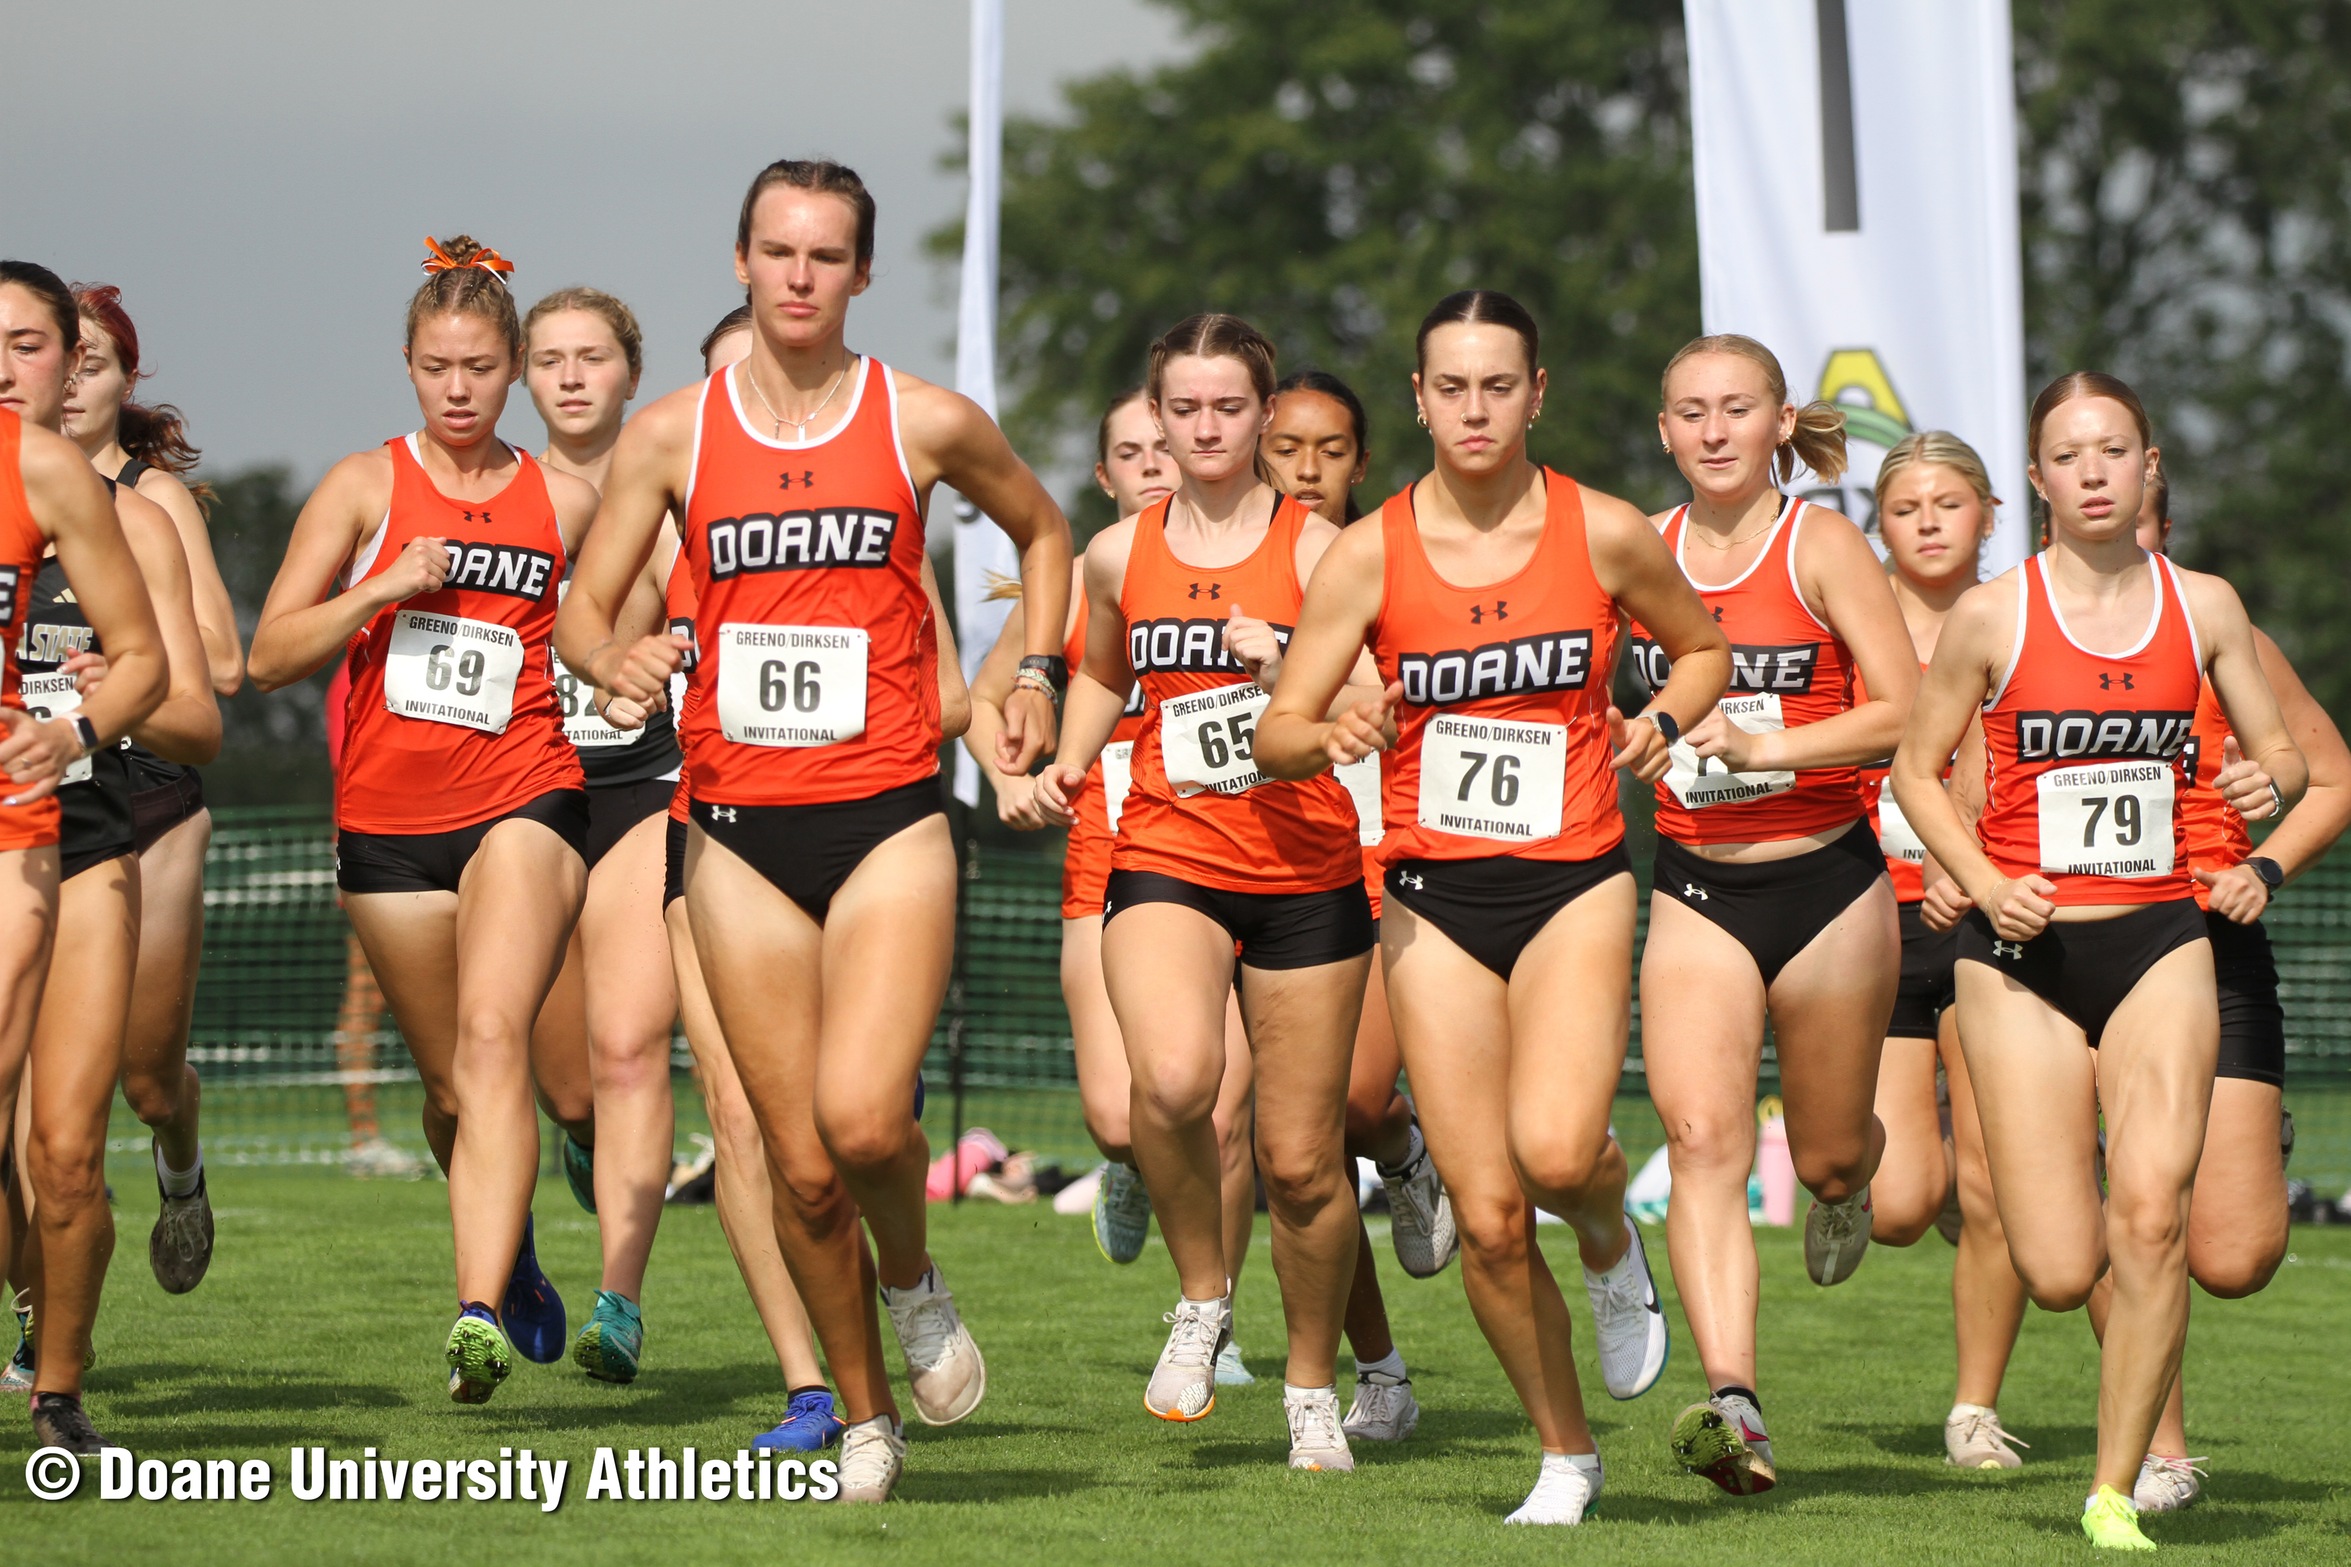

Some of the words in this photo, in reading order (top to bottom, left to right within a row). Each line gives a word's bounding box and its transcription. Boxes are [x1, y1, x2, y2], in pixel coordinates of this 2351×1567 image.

[710, 514, 892, 574] DOANE
[444, 545, 551, 597] OANE
[409, 616, 514, 647] GREENO/DIRKSEN
[736, 631, 850, 649] GREENO/DIRKSEN
[425, 644, 485, 696] 69
[1402, 637, 1588, 703] DOANE
[1632, 645, 1811, 688] DONE
[759, 659, 821, 713] 66
[1173, 685, 1265, 718] GREENO/DIRKSE
[405, 700, 490, 725] INVITATIONAL
[743, 726, 837, 741] INVITATIONAL
[1197, 712, 1255, 769] 65
[1436, 720, 1551, 746] GREENO/DIRKSEN
[1457, 750, 1521, 807] 76
[1685, 782, 1773, 804] INVITATIONAL
[2053, 766, 2162, 788] GREENO/DIRKSEN
[1440, 814, 1533, 837] INVITATIONAL
[2081, 794, 2142, 848] 79
[2067, 858, 2157, 875] INVITATIONAL
